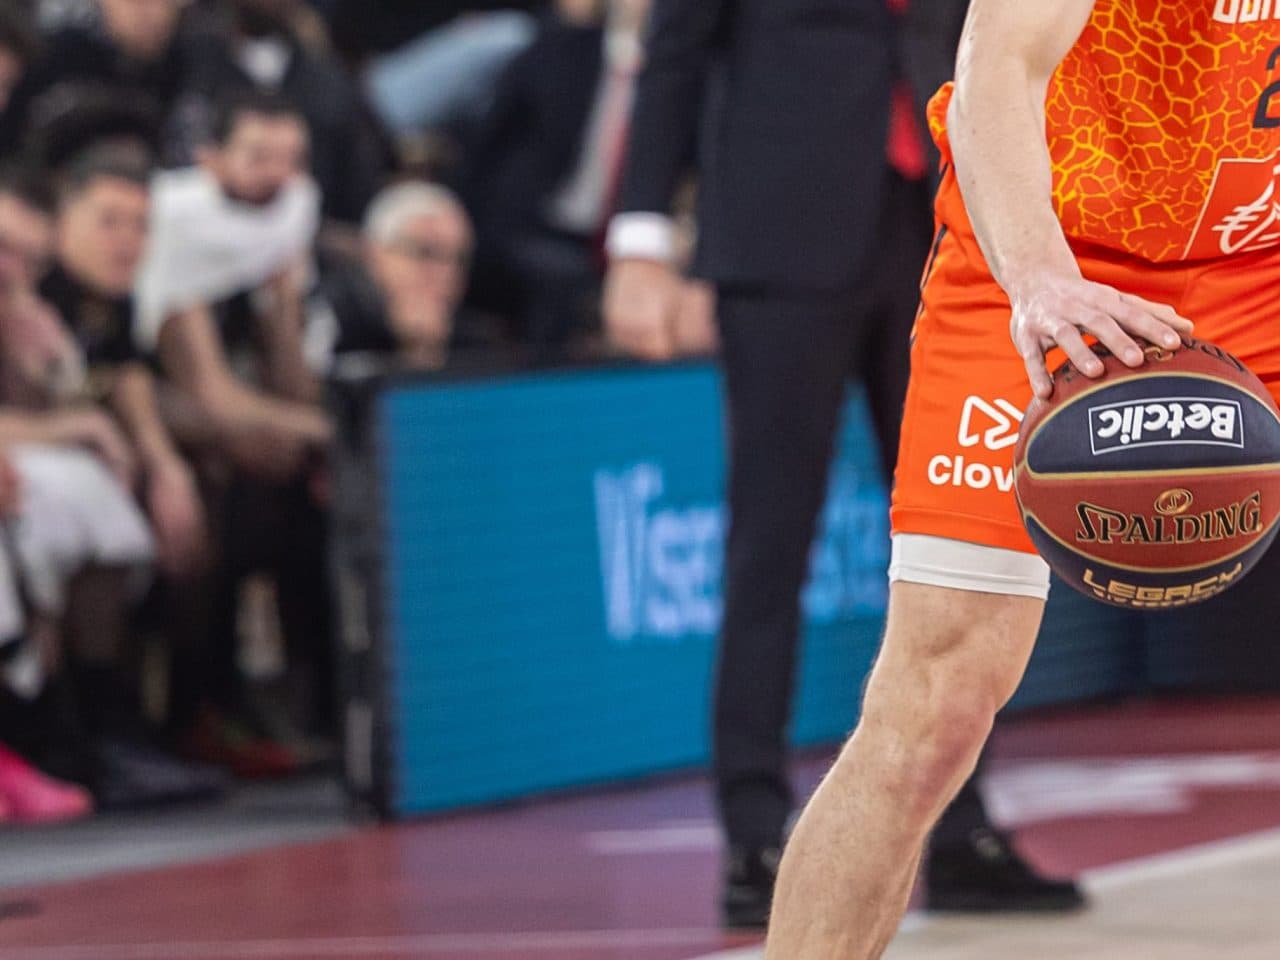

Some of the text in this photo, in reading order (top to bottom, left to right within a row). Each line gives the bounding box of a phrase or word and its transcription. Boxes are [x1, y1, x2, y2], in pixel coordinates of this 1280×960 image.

[1097, 402, 1236, 445] Betclic
[1075, 490, 1263, 545] SPALDING
[1083, 561, 1243, 602] LEGACY
